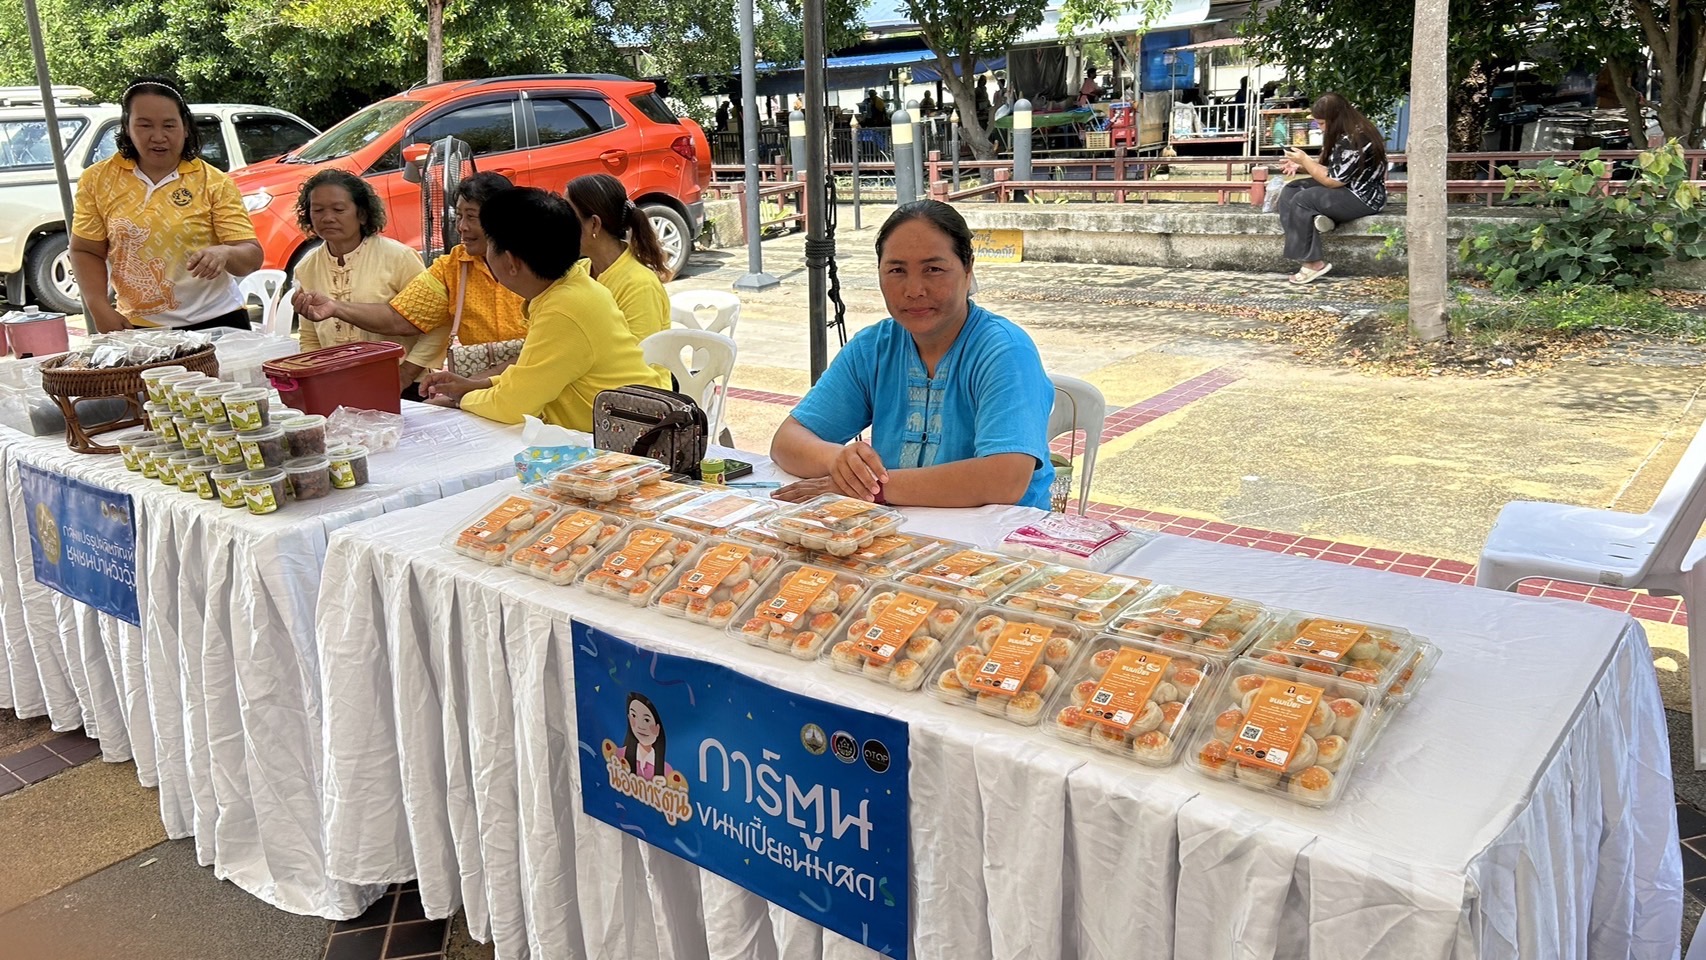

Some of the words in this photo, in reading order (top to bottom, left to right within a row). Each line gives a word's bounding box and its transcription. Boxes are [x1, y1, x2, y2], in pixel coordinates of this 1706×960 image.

[607, 757, 691, 823] น้องการ์ตูน
[698, 737, 873, 851] การ์ตูน
[864, 749, 889, 763] OTOP
[696, 801, 875, 901] ขนมเปี๊ยะนมสด
